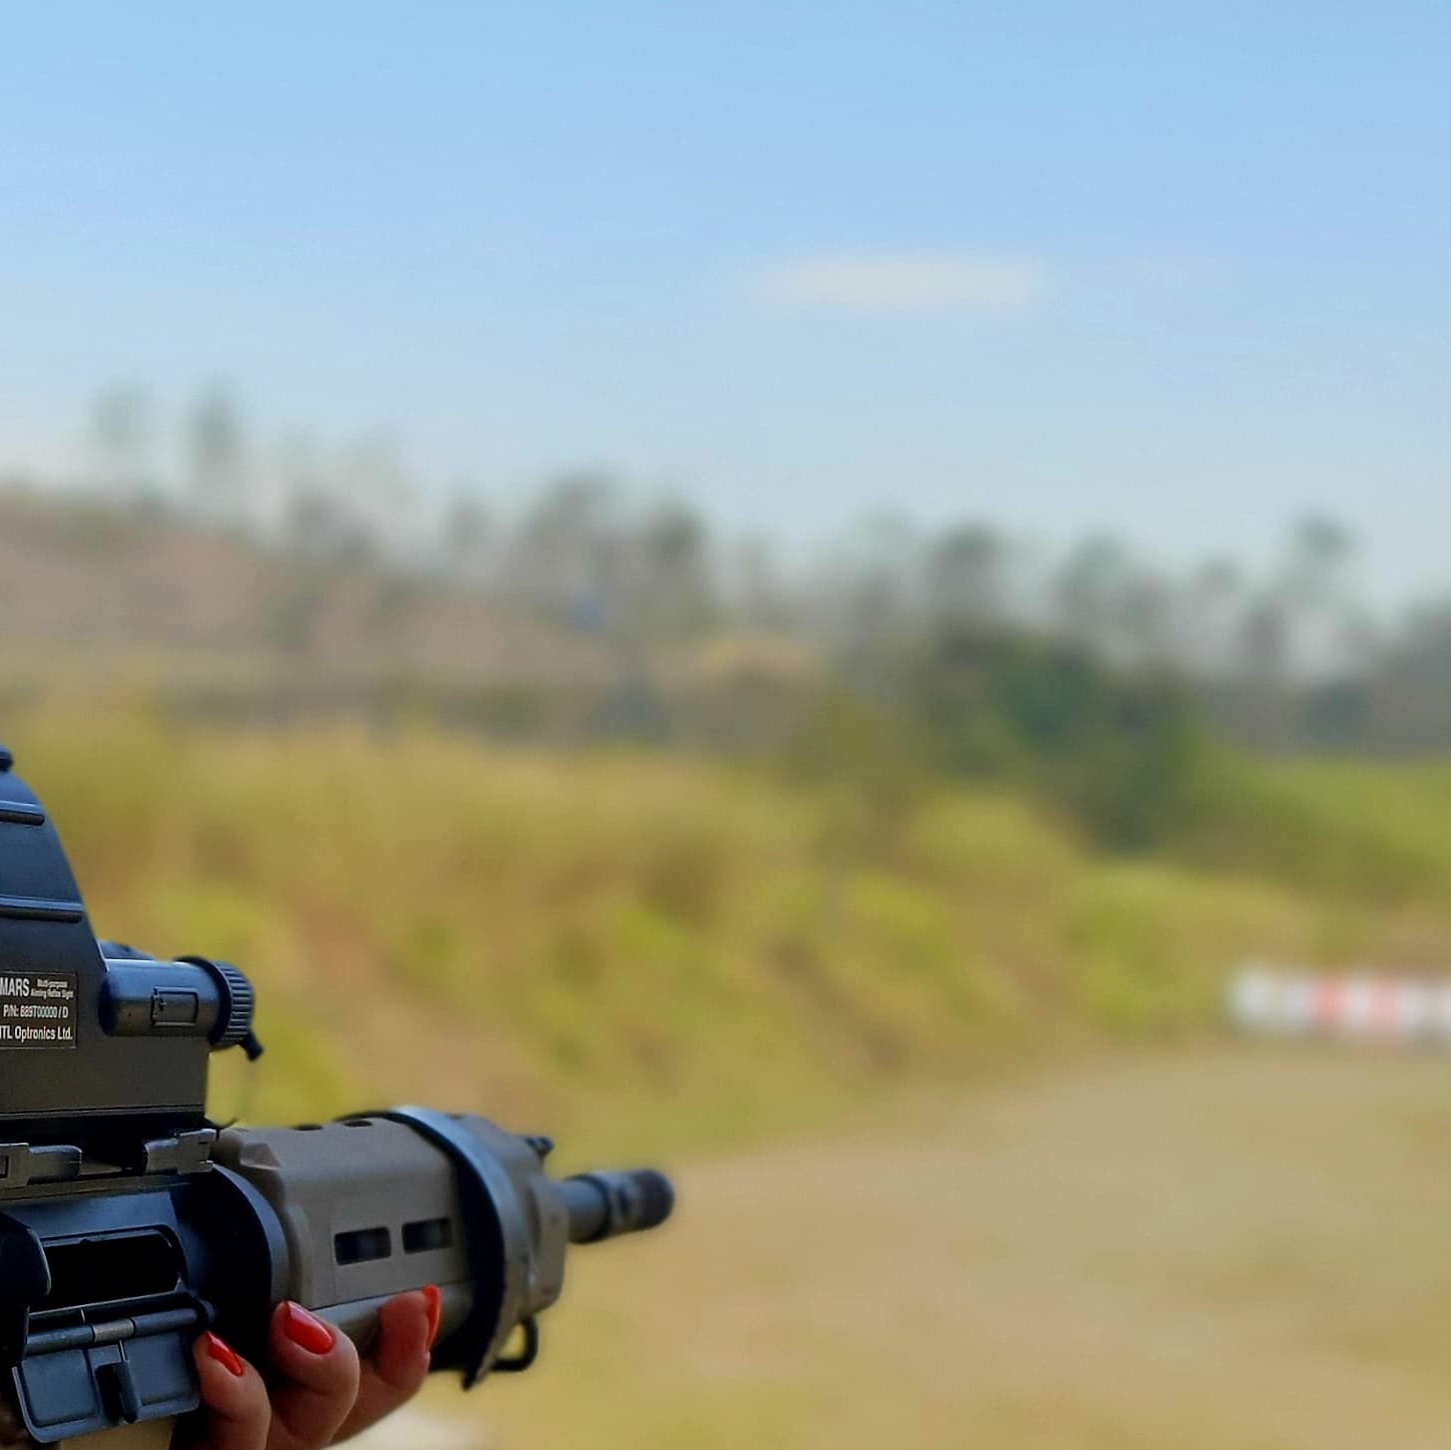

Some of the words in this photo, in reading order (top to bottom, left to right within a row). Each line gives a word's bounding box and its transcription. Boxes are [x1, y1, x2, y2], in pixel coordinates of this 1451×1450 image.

[0, 977, 30, 997] MARS
[3, 1004, 19, 1017] P/N:
[62, 1006, 69, 1018] D
[14, 1025, 55, 1043] Optronics
[57, 1026, 73, 1042] Ltd.
